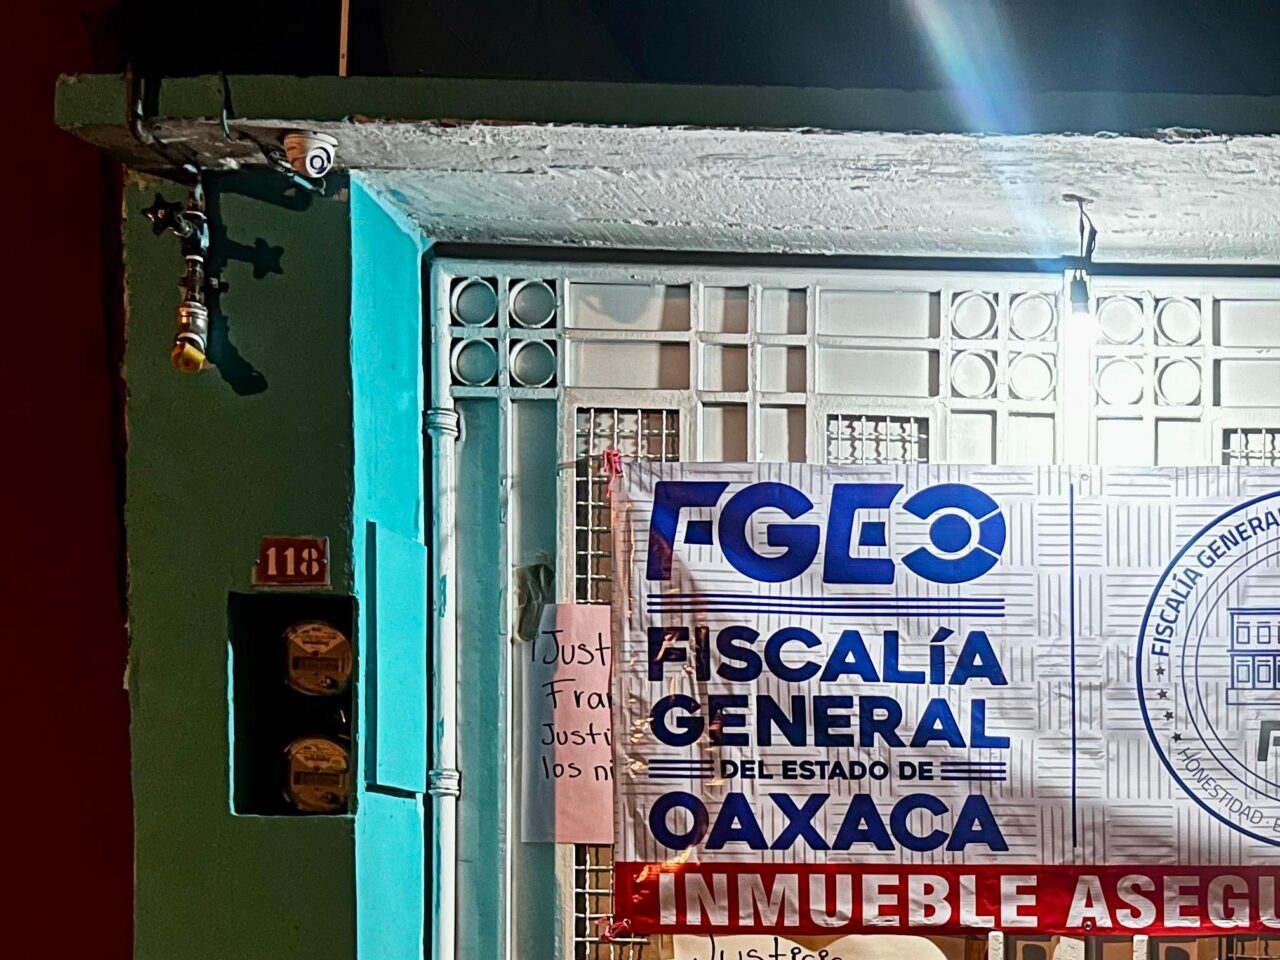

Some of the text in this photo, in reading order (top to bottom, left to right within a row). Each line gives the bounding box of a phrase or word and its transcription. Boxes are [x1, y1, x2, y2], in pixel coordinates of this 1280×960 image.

[646, 480, 1007, 585] FGEO
[265, 547, 320, 576] 118
[1151, 567, 1204, 657] FISCALÍA
[649, 694, 1011, 749] GENERAL
[542, 756, 582, 779] los
[720, 759, 935, 781] DEL ESTADO DE
[1178, 747, 1264, 825] HONESTIDAD
[648, 791, 1010, 853] OAXACA
[658, 872, 1038, 928] INMUEBLE
